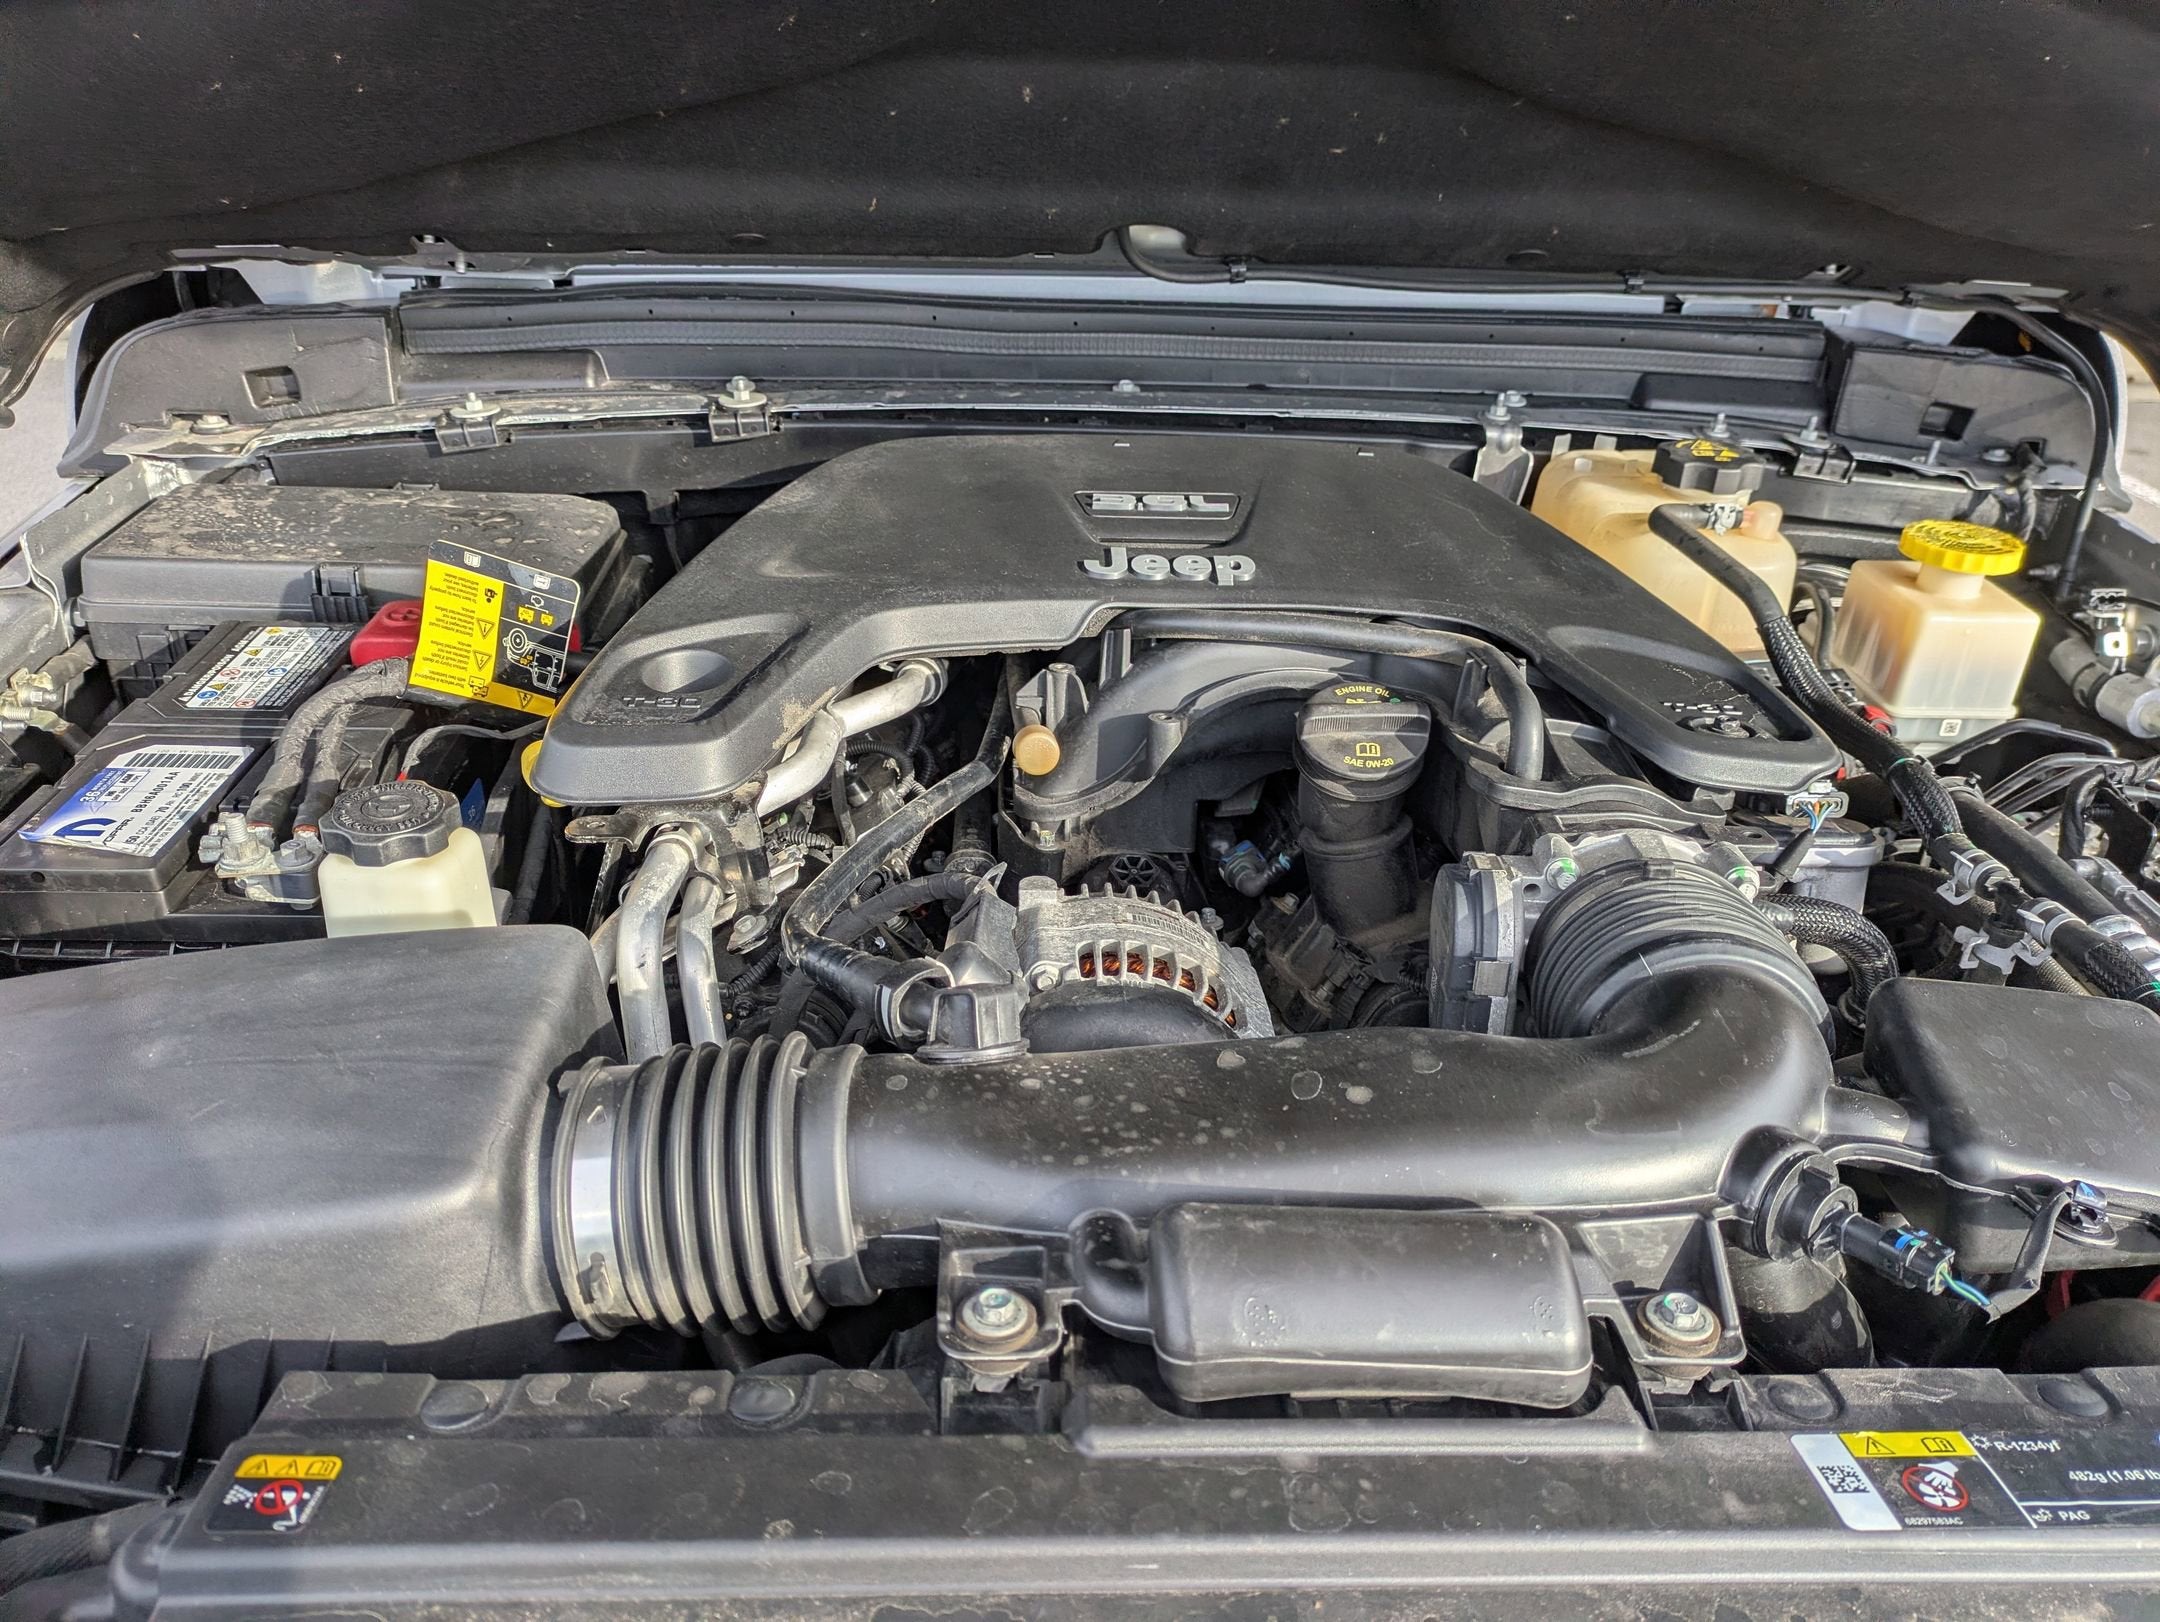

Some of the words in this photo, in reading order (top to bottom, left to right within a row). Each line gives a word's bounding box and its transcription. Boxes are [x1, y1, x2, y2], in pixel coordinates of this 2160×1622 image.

[1092, 493, 1230, 512] 3.6L
[1083, 546, 1256, 586] Jeep
[1334, 685, 1373, 696] ENGINE
[1374, 686, 1390, 697] OIL
[1343, 756, 1365, 768] SAE
[1366, 757, 1394, 768] 0W-20
[80, 791, 101, 802] 36
[1993, 1439, 2062, 1453] R-1234yf
[2069, 1470, 2108, 1483] 482g
[2106, 1469, 2145, 1483] (1.06
[2058, 1510, 2090, 1522] PAG
